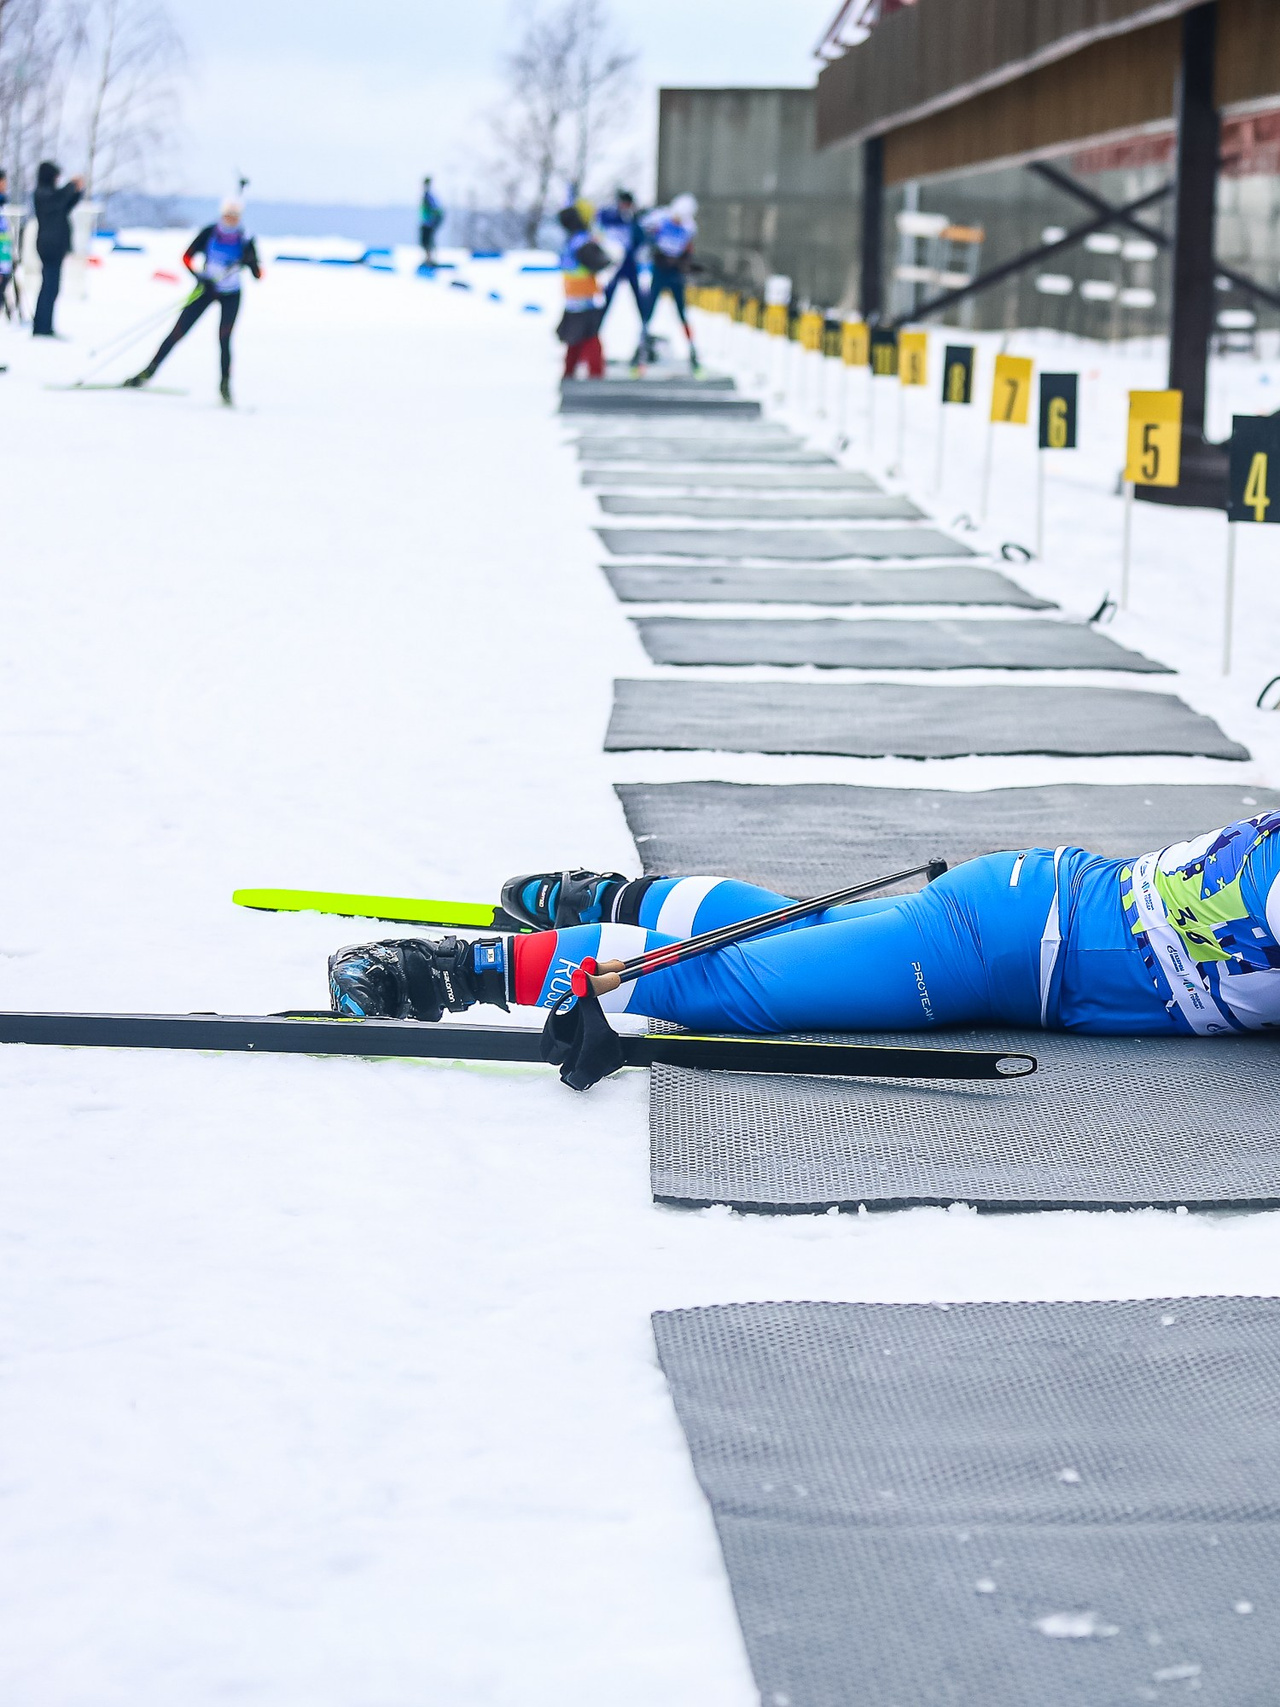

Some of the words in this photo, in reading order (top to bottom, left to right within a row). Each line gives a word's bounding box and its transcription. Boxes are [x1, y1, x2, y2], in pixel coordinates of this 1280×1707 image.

[1004, 377, 1019, 421] 7
[1047, 396, 1068, 448] 6
[1141, 423, 1160, 481] 5
[1243, 452, 1270, 522] 4
